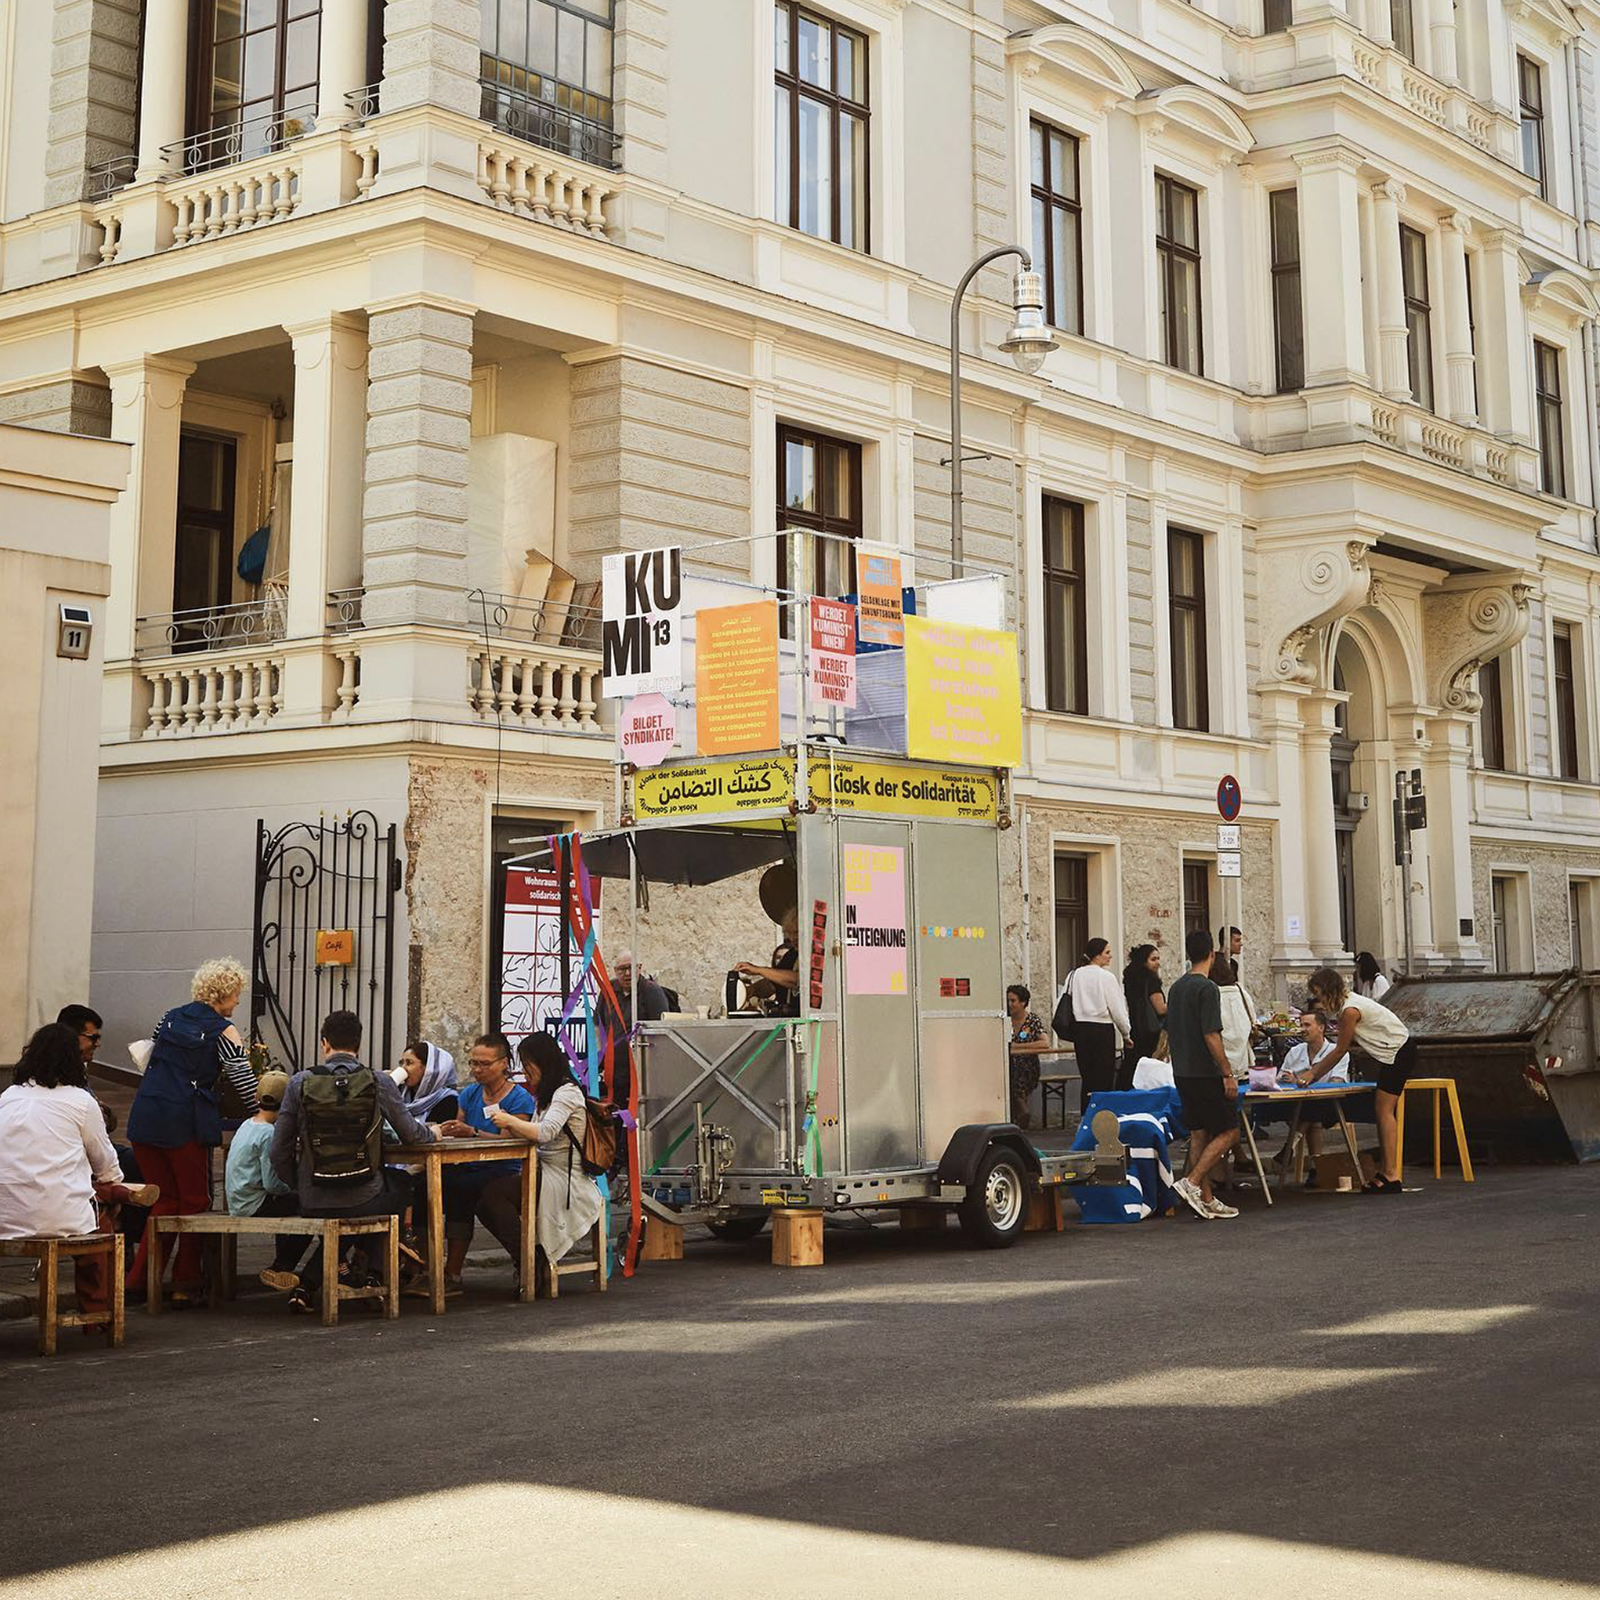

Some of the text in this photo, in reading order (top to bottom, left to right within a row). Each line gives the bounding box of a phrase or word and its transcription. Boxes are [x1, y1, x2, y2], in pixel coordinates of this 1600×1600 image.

[625, 548, 681, 616] KU
[861, 606, 902, 620] ZUKUNFTSBONUS
[890, 600, 900, 608] MIT
[818, 605, 847, 623] WERDET
[68, 631, 82, 648] 11
[821, 634, 846, 651] INNEN!
[820, 657, 847, 673] WERDET
[822, 686, 846, 702] INNEN!
[633, 715, 663, 731] BILDET
[623, 728, 674, 746] SYNDIKATE!
[638, 767, 707, 790] Kiosk der Solidarität
[658, 771, 772, 806] كشك التضامن
[829, 772, 977, 804] Kiosk der Solidarität
[638, 798, 698, 816] Kiosk of Solidarity
[524, 876, 558, 887] Wohnraum
[846, 905, 857, 924] IN
[846, 927, 906, 948] ENTEIGNUNG
